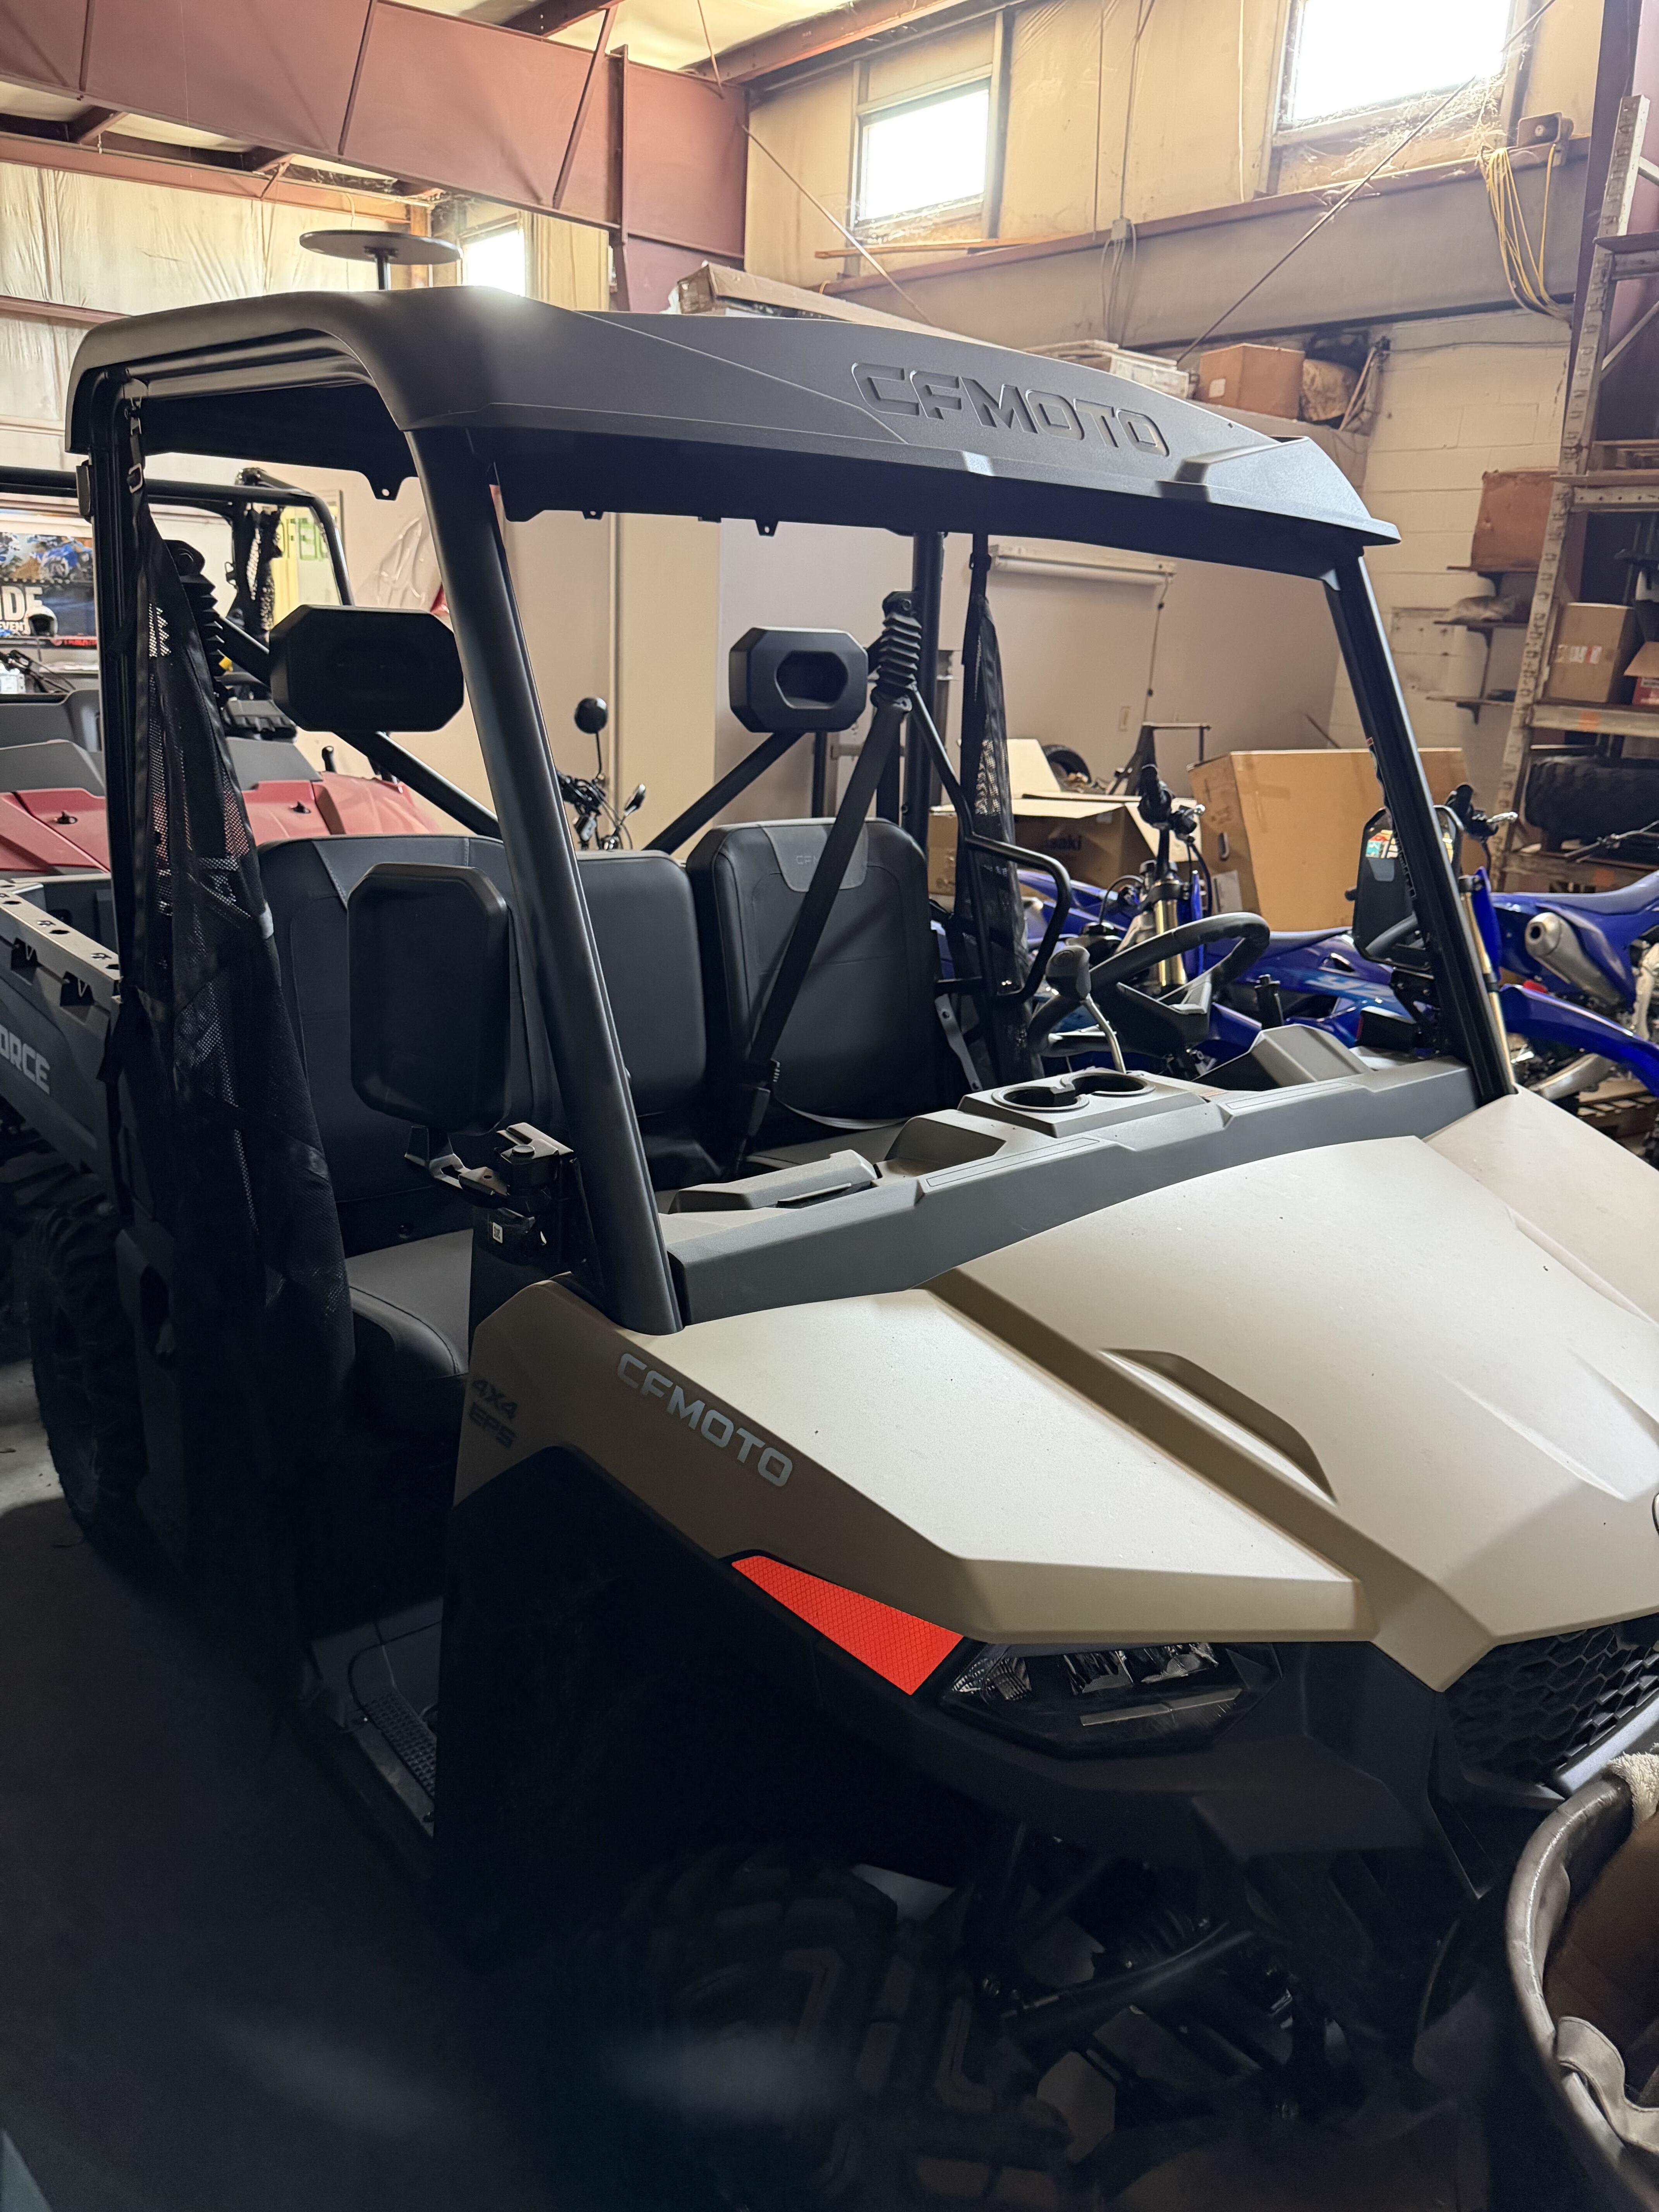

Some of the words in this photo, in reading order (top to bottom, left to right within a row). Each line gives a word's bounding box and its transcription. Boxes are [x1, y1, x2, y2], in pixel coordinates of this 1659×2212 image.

[852, 362, 1170, 457] CFMOTO
[0, 586, 43, 621] DE
[469, 1401, 518, 1450] EPS
[617, 1353, 793, 1487] CFMOTO
